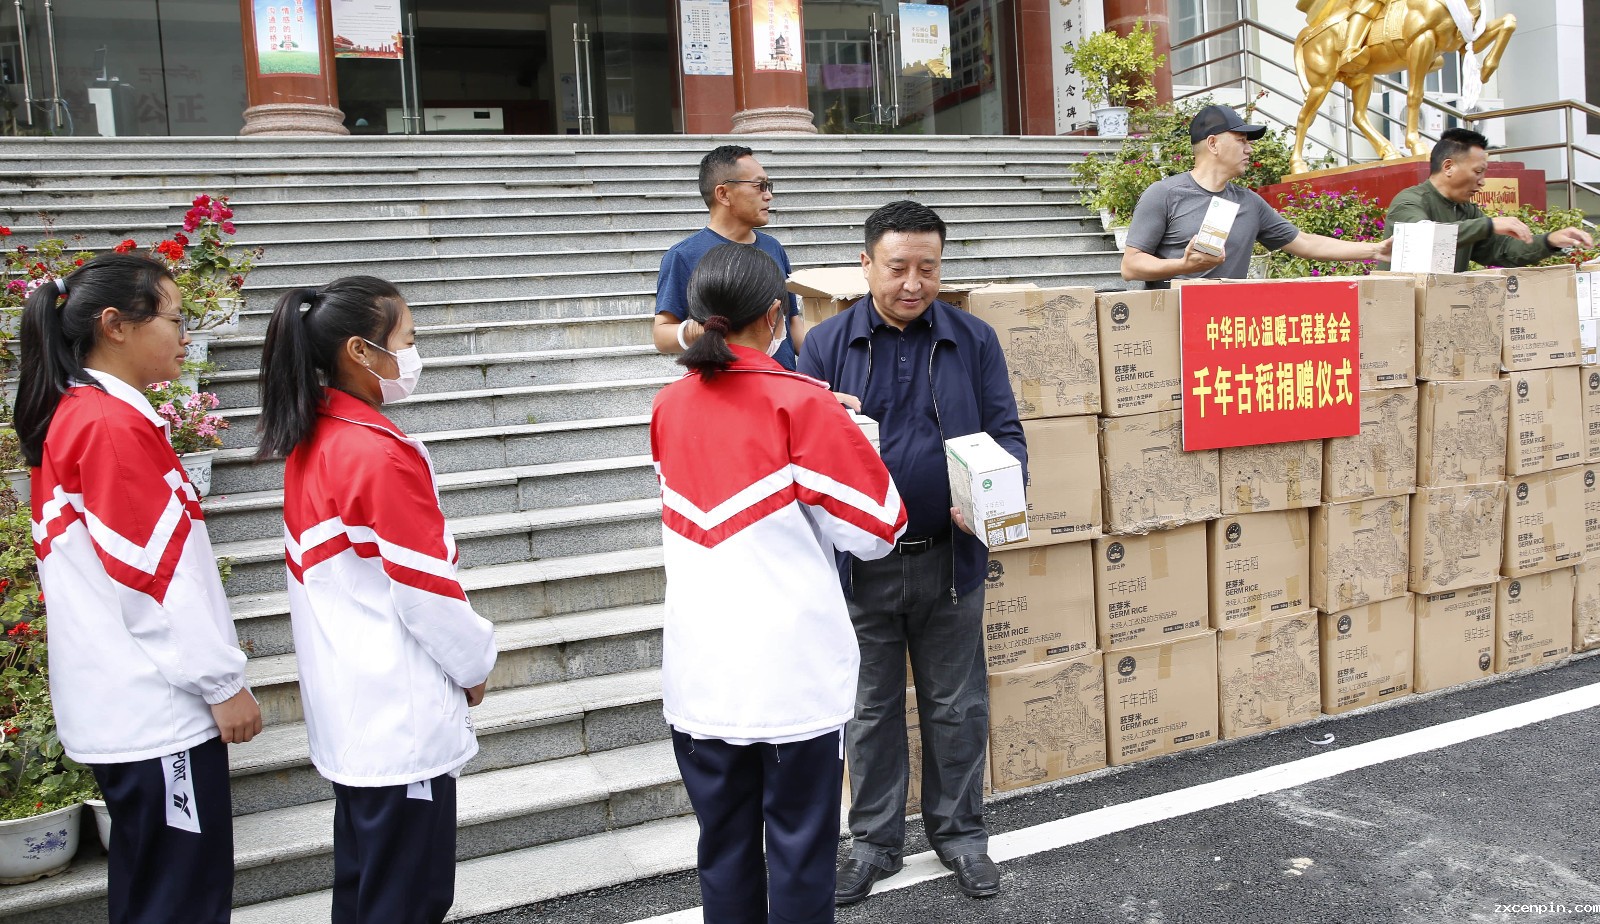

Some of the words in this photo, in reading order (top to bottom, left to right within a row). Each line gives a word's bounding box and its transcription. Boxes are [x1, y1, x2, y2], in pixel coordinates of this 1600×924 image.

[1206, 312, 1351, 350] 中华同心温暖工程基金会
[1114, 340, 1152, 359] 千年古稻
[1114, 364, 1136, 374] 胚芽米
[1115, 372, 1136, 382] GERM
[1138, 371, 1154, 379] RICE
[1192, 358, 1353, 418] 千年古稻捐赠仪式
[1518, 410, 1544, 426] 千年古稻
[1518, 512, 1544, 528] 千年古稻
[1226, 556, 1258, 575] 千年古稻
[1108, 576, 1146, 596] 千年古稻
[1226, 579, 1244, 589] 胚芽米
[1226, 587, 1244, 596] GERM
[1244, 584, 1258, 592] RICE
[986, 596, 1028, 617] 千年古稻
[1109, 600, 1130, 612] 胚芽米
[1109, 610, 1130, 620] GERM
[1132, 606, 1148, 614] RICE
[1508, 610, 1534, 626] 千年古稻
[987, 622, 1010, 634] 胚芽米
[987, 631, 1010, 640] GERM
[1012, 627, 1028, 636] RICE
[1338, 645, 1368, 664] 千年古稻
[1338, 676, 1354, 684] GERM
[1355, 672, 1368, 680] RICE
[1120, 688, 1158, 710] 千年古稻
[1120, 713, 1142, 724] 胚芽米
[1120, 722, 1141, 732] GERM
[1142, 718, 1158, 726] RICE
